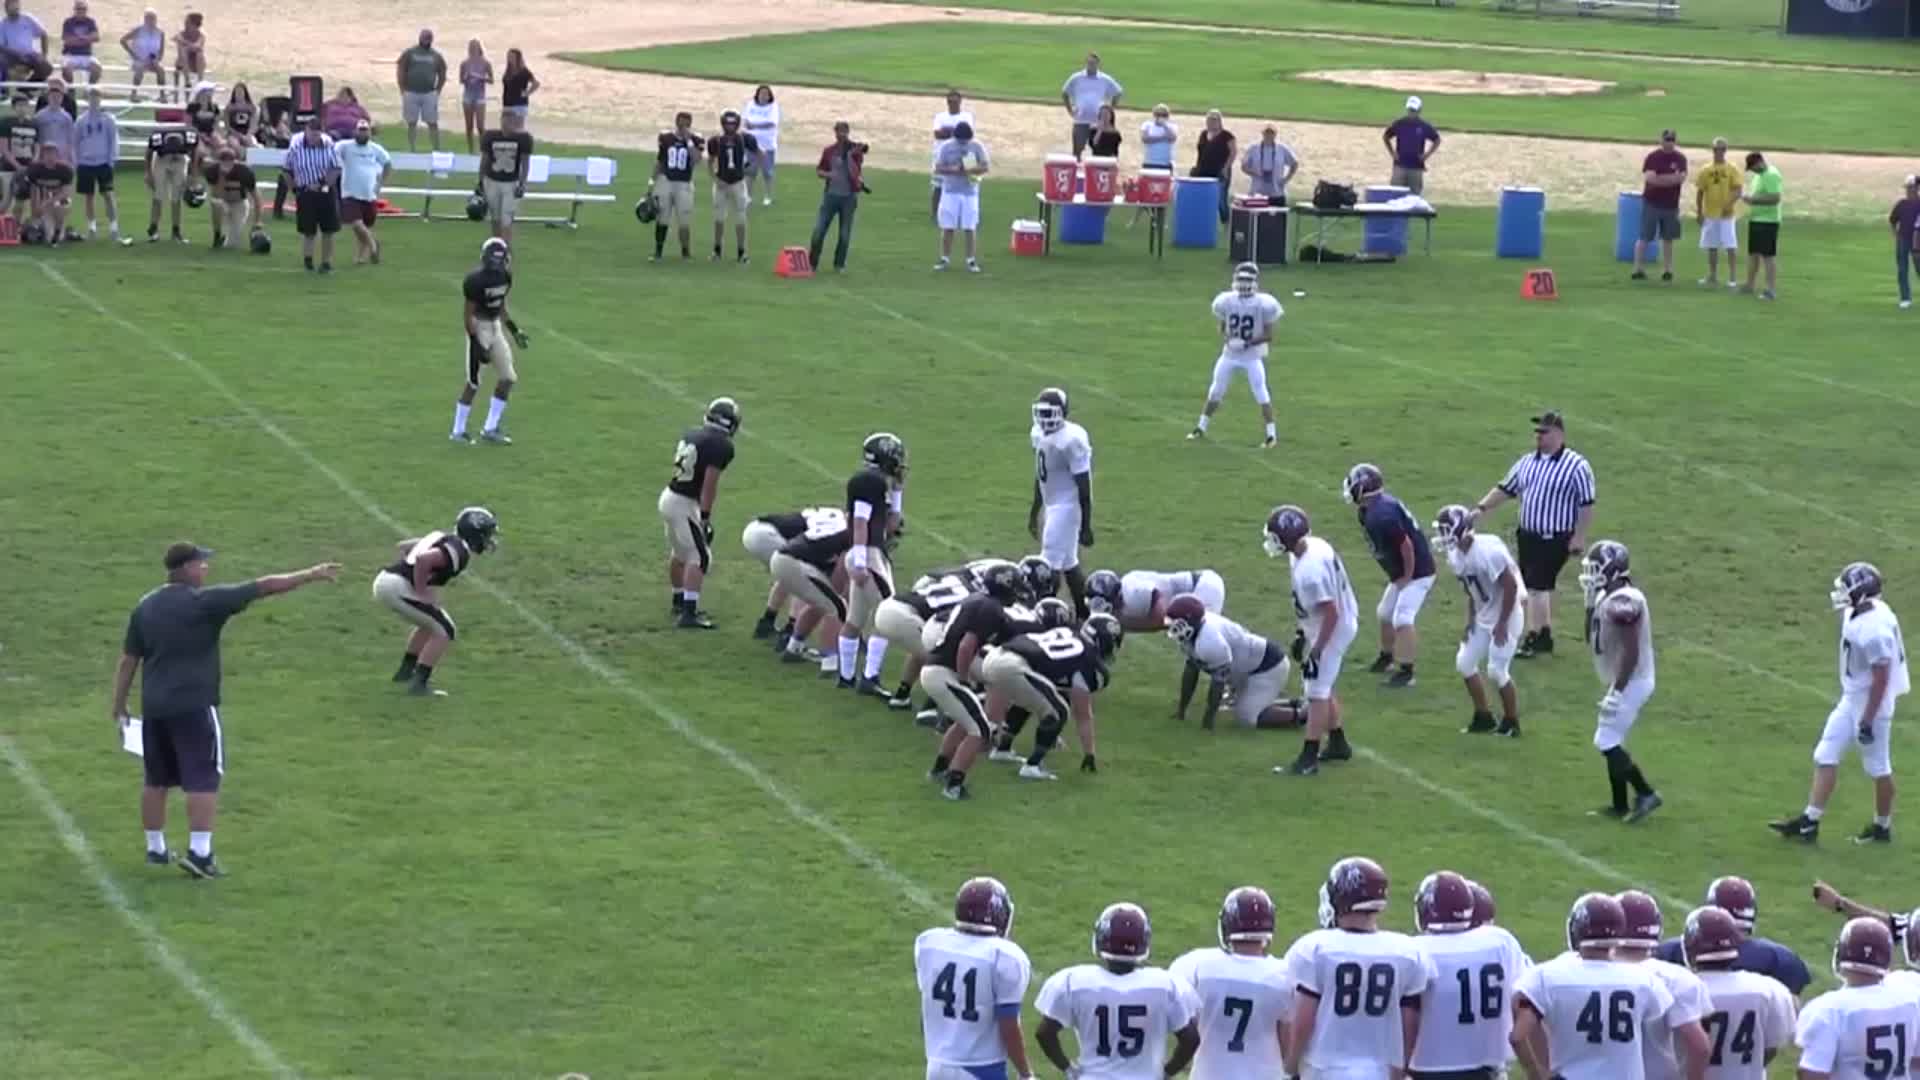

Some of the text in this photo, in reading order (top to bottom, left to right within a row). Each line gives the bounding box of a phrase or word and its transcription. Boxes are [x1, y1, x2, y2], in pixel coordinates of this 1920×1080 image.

[298, 80, 313, 112] 1
[784, 249, 809, 272] 30
[1529, 271, 1553, 296] 20
[1229, 313, 1254, 341] 22
[932, 962, 979, 1022] 41
[1334, 961, 1395, 1017] 88
[1456, 962, 1505, 1025] 16
[1575, 989, 1636, 1044] 46
[1095, 1004, 1147, 1057] 15
[1223, 996, 1253, 1053] 7
[1702, 1009, 1756, 1066] 74
[1863, 1022, 1906, 1078] 51
